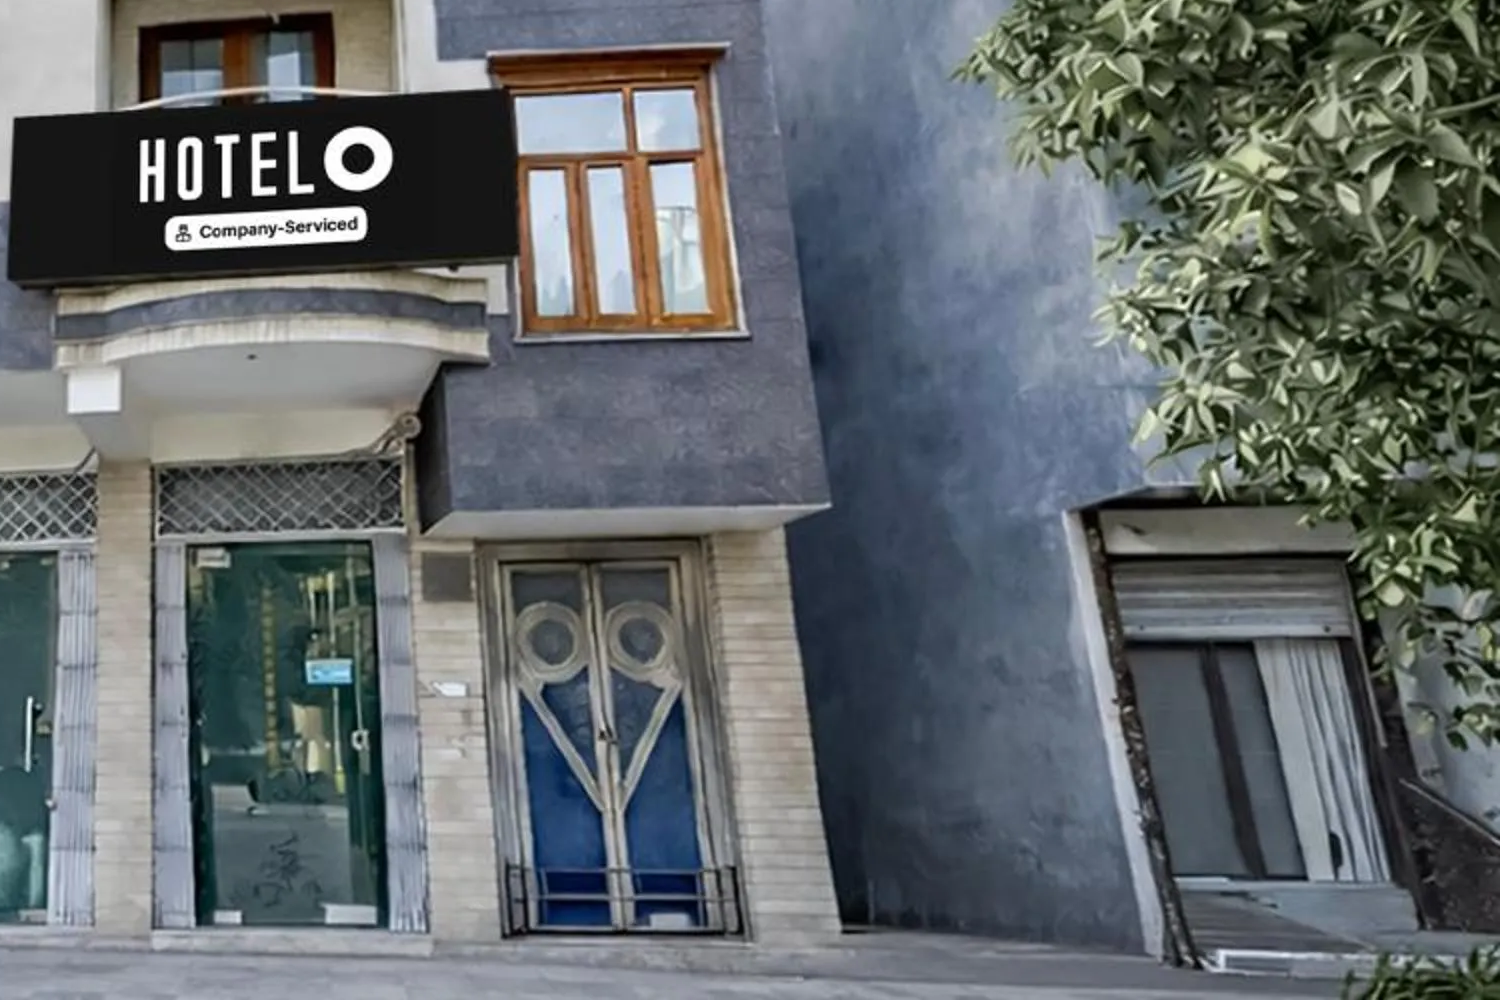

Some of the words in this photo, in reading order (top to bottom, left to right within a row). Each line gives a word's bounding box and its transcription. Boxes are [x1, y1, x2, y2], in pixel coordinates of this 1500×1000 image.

[139, 131, 315, 203] HOTEL
[323, 126, 393, 192] O
[199, 216, 359, 240] Company-Serviced
